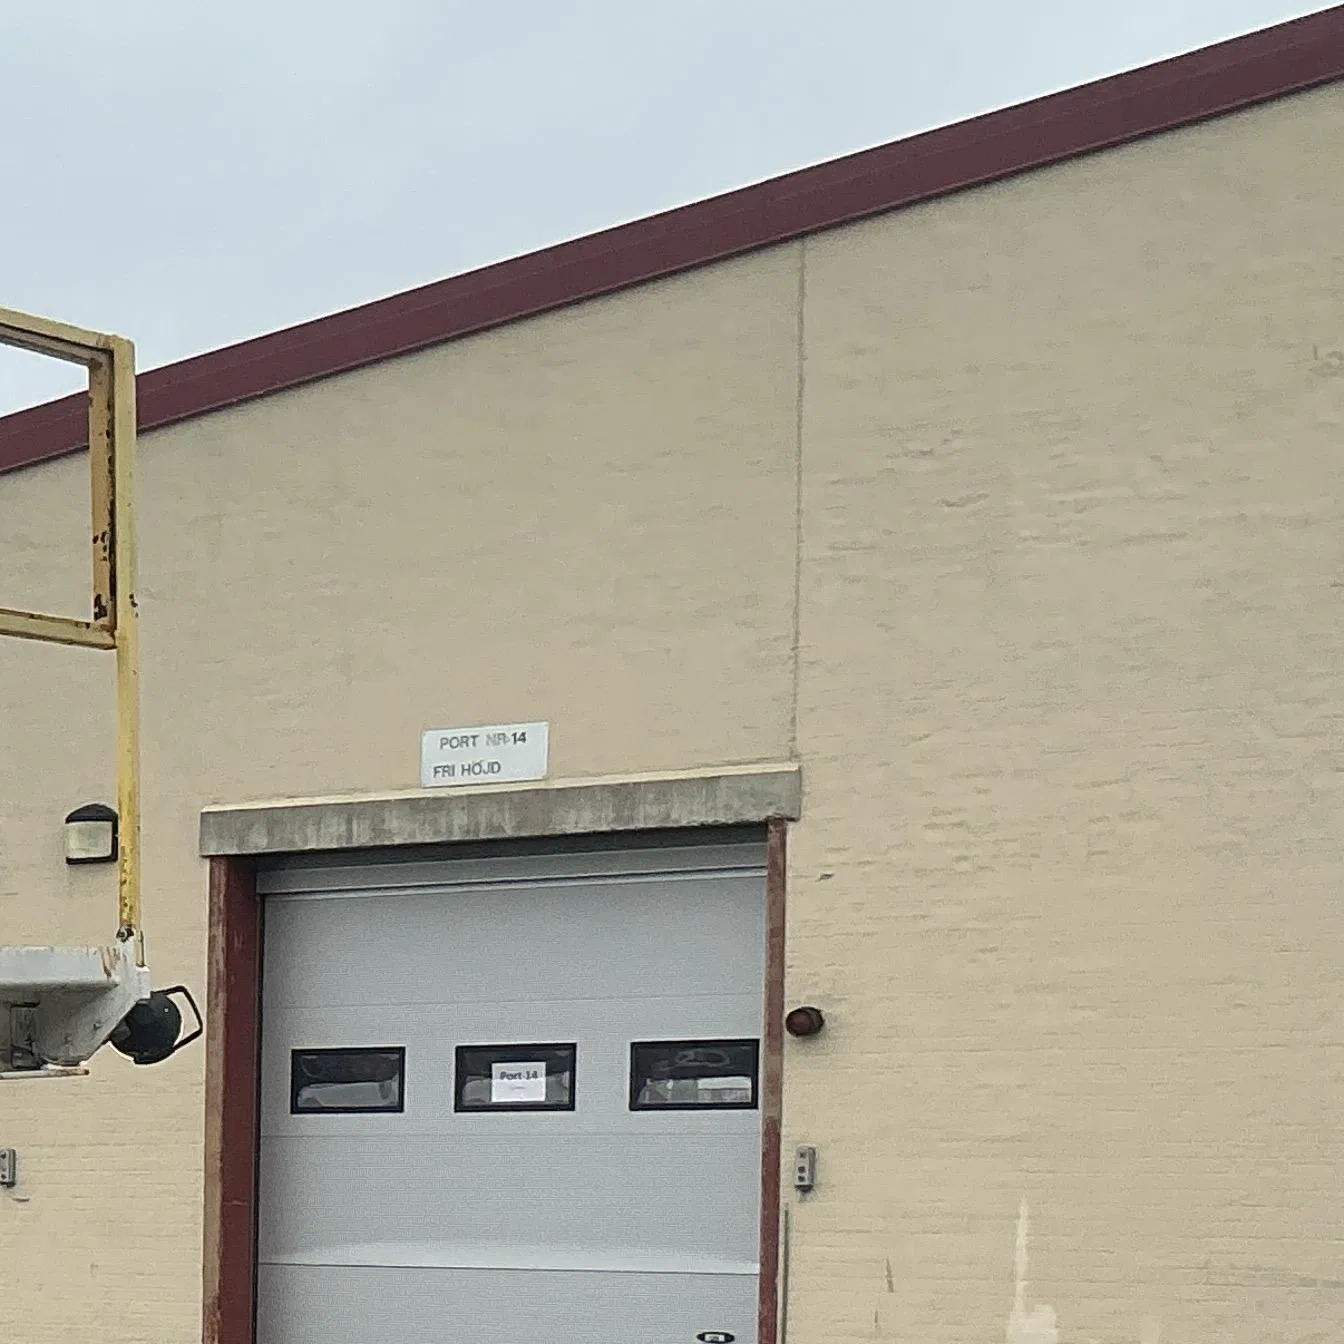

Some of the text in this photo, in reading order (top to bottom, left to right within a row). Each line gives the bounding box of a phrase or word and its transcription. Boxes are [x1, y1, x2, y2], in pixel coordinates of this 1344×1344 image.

[439, 734, 479, 750] PORT
[511, 732, 527, 745] 14
[433, 765, 455, 778] FRI
